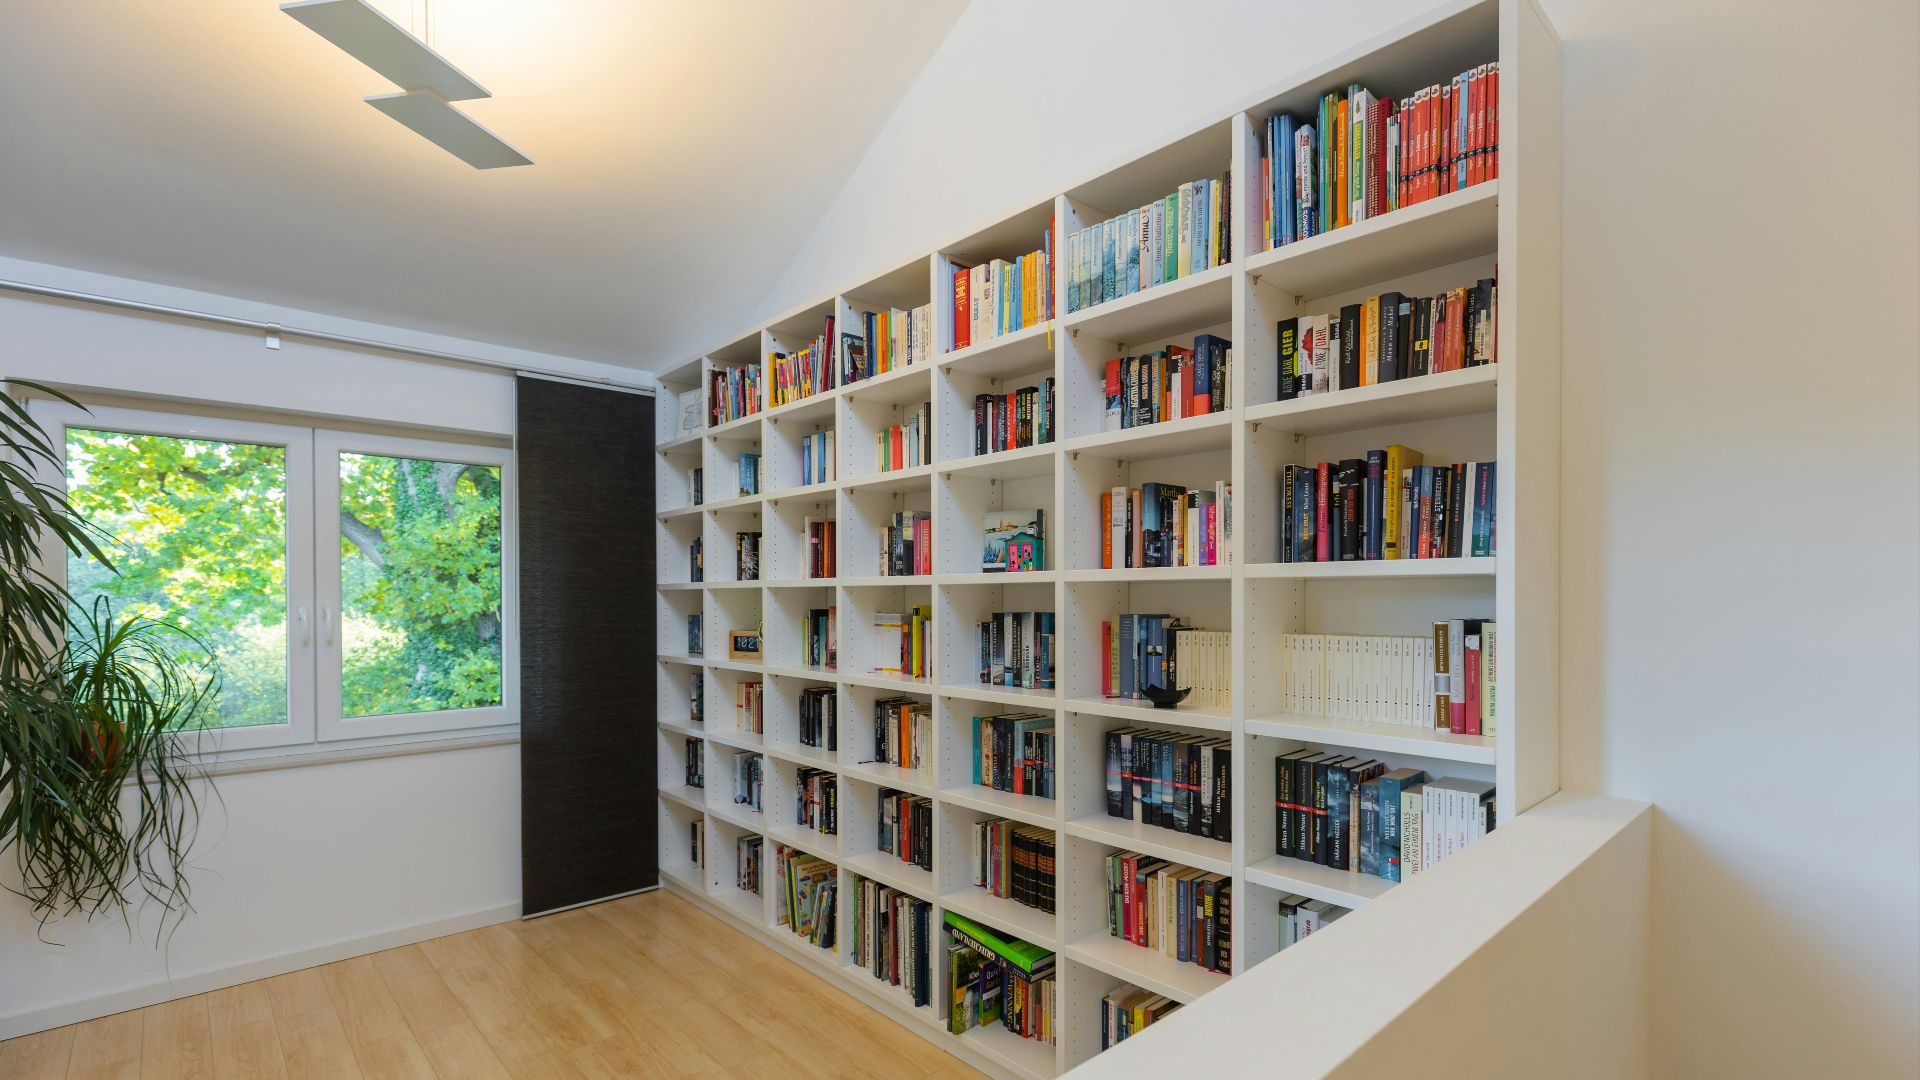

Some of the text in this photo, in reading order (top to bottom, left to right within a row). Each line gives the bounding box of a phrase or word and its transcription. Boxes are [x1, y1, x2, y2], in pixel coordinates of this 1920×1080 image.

[1282, 329, 1293, 393] ARNE DAHL GIER
[1315, 326, 1327, 370] ARNE DAHL
[1131, 385, 1139, 408] AGATHA
[1412, 849, 1418, 858] AN
[952, 928, 995, 961] GRIECHENLAND
